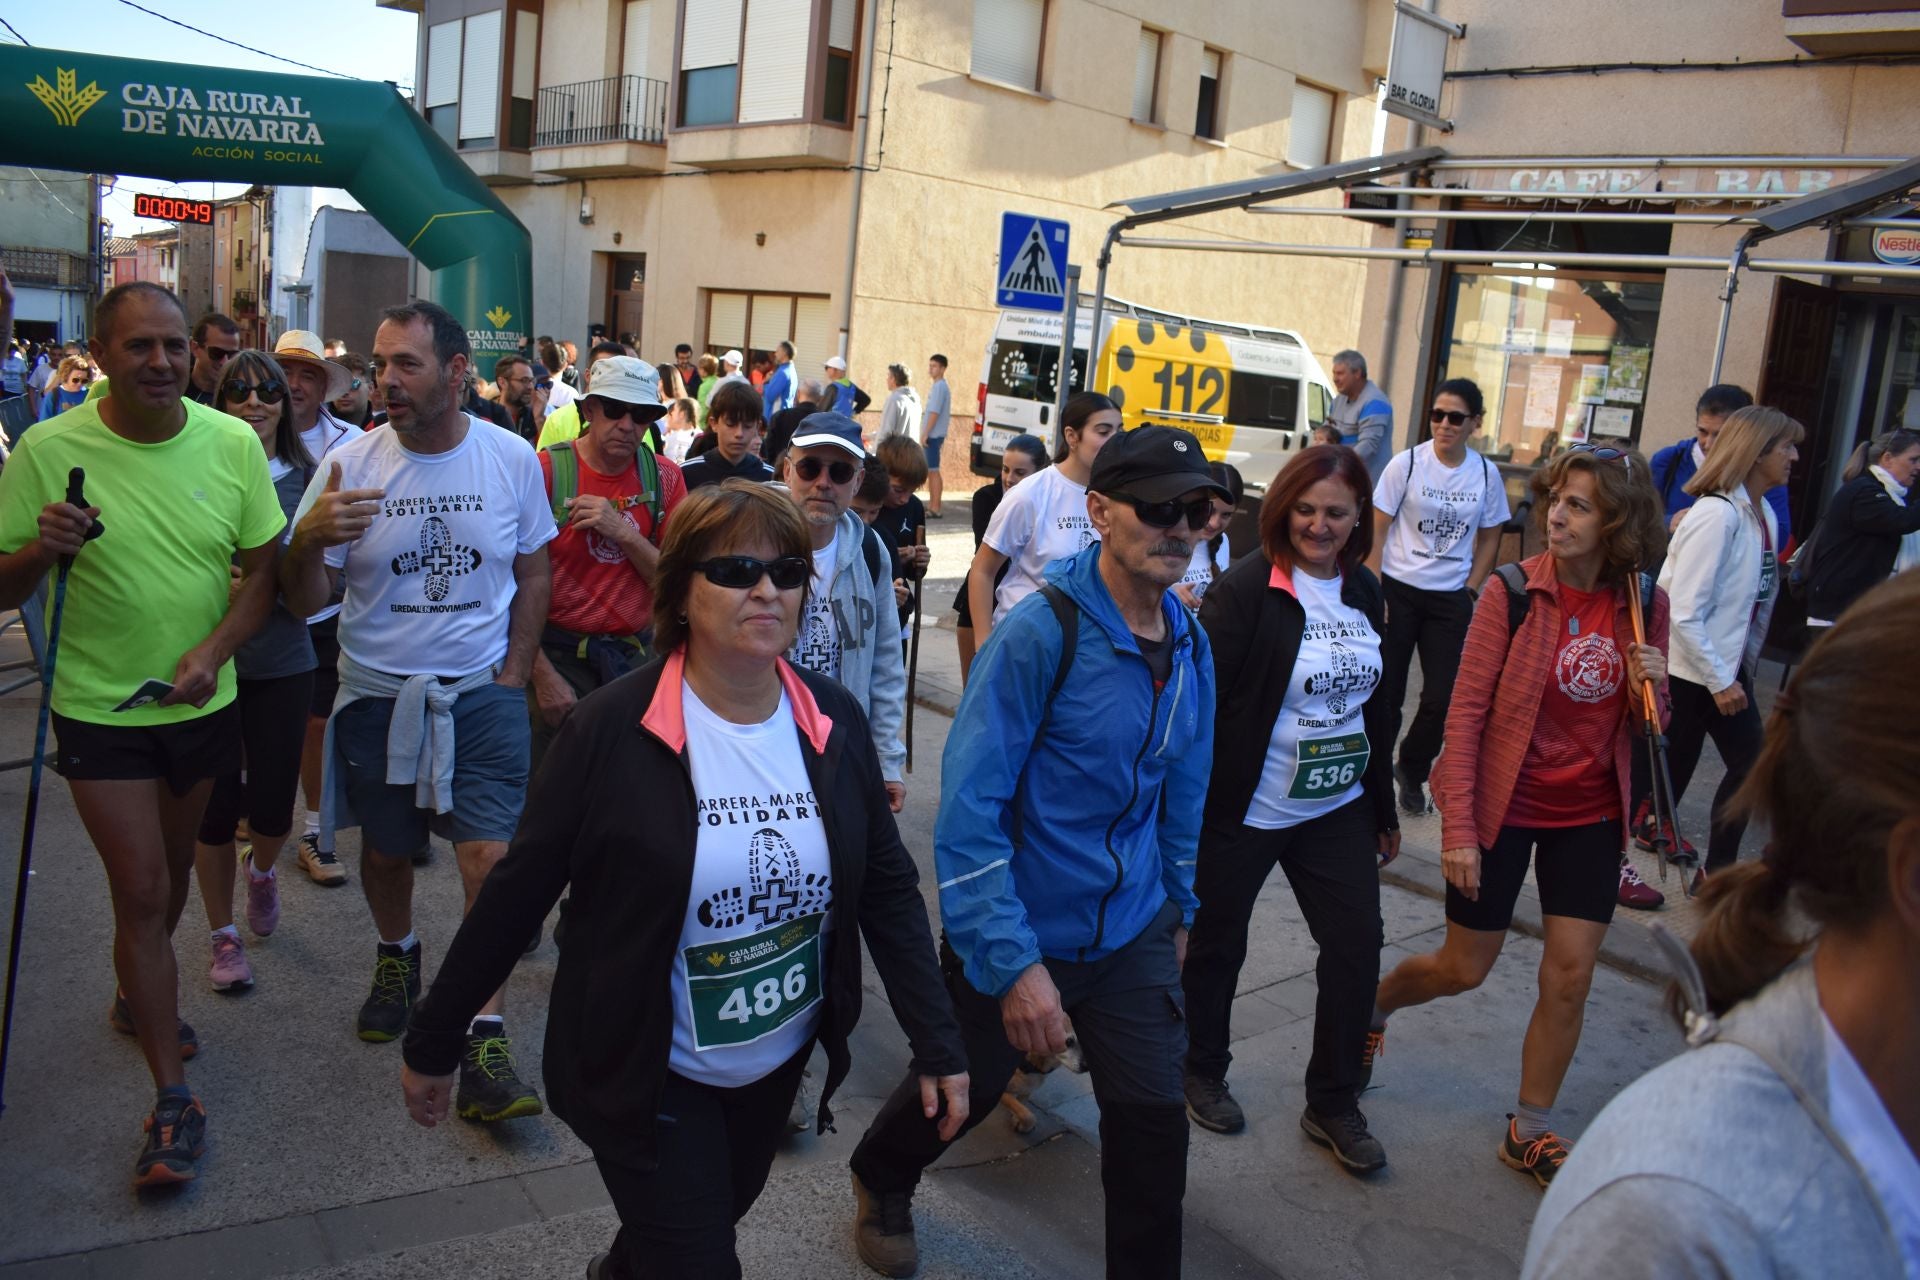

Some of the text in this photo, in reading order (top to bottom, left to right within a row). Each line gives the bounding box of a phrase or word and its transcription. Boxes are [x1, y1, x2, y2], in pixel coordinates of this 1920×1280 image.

[122, 83, 311, 118] CAJA RURAL
[1391, 84, 1435, 111] BAR GLORIA
[122, 109, 325, 145] DE NAVARRA
[192, 146, 323, 164] ACCIÓN SOCIAL
[1510, 169, 1641, 193] CAFE
[1715, 169, 1833, 193] BAR
[138, 197, 211, 222] 00:00:49
[466, 330, 493, 340] CAJA
[1018, 328, 1075, 341] ambulan
[1012, 361, 1027, 374] 112
[1154, 360, 1224, 422] 112
[385, 503, 483, 518] SOLIDARIA
[1303, 629, 1368, 640] OLIDARIA
[1306, 763, 1356, 790] 536
[698, 792, 815, 812] ARRERA-MARC
[698, 806, 822, 827] OLIDARI
[729, 949, 749, 958] CAJA
[750, 940, 775, 954] RURAL
[730, 956, 742, 965] DE
[743, 945, 779, 962] NAVARRA
[718, 963, 807, 1024] 486
